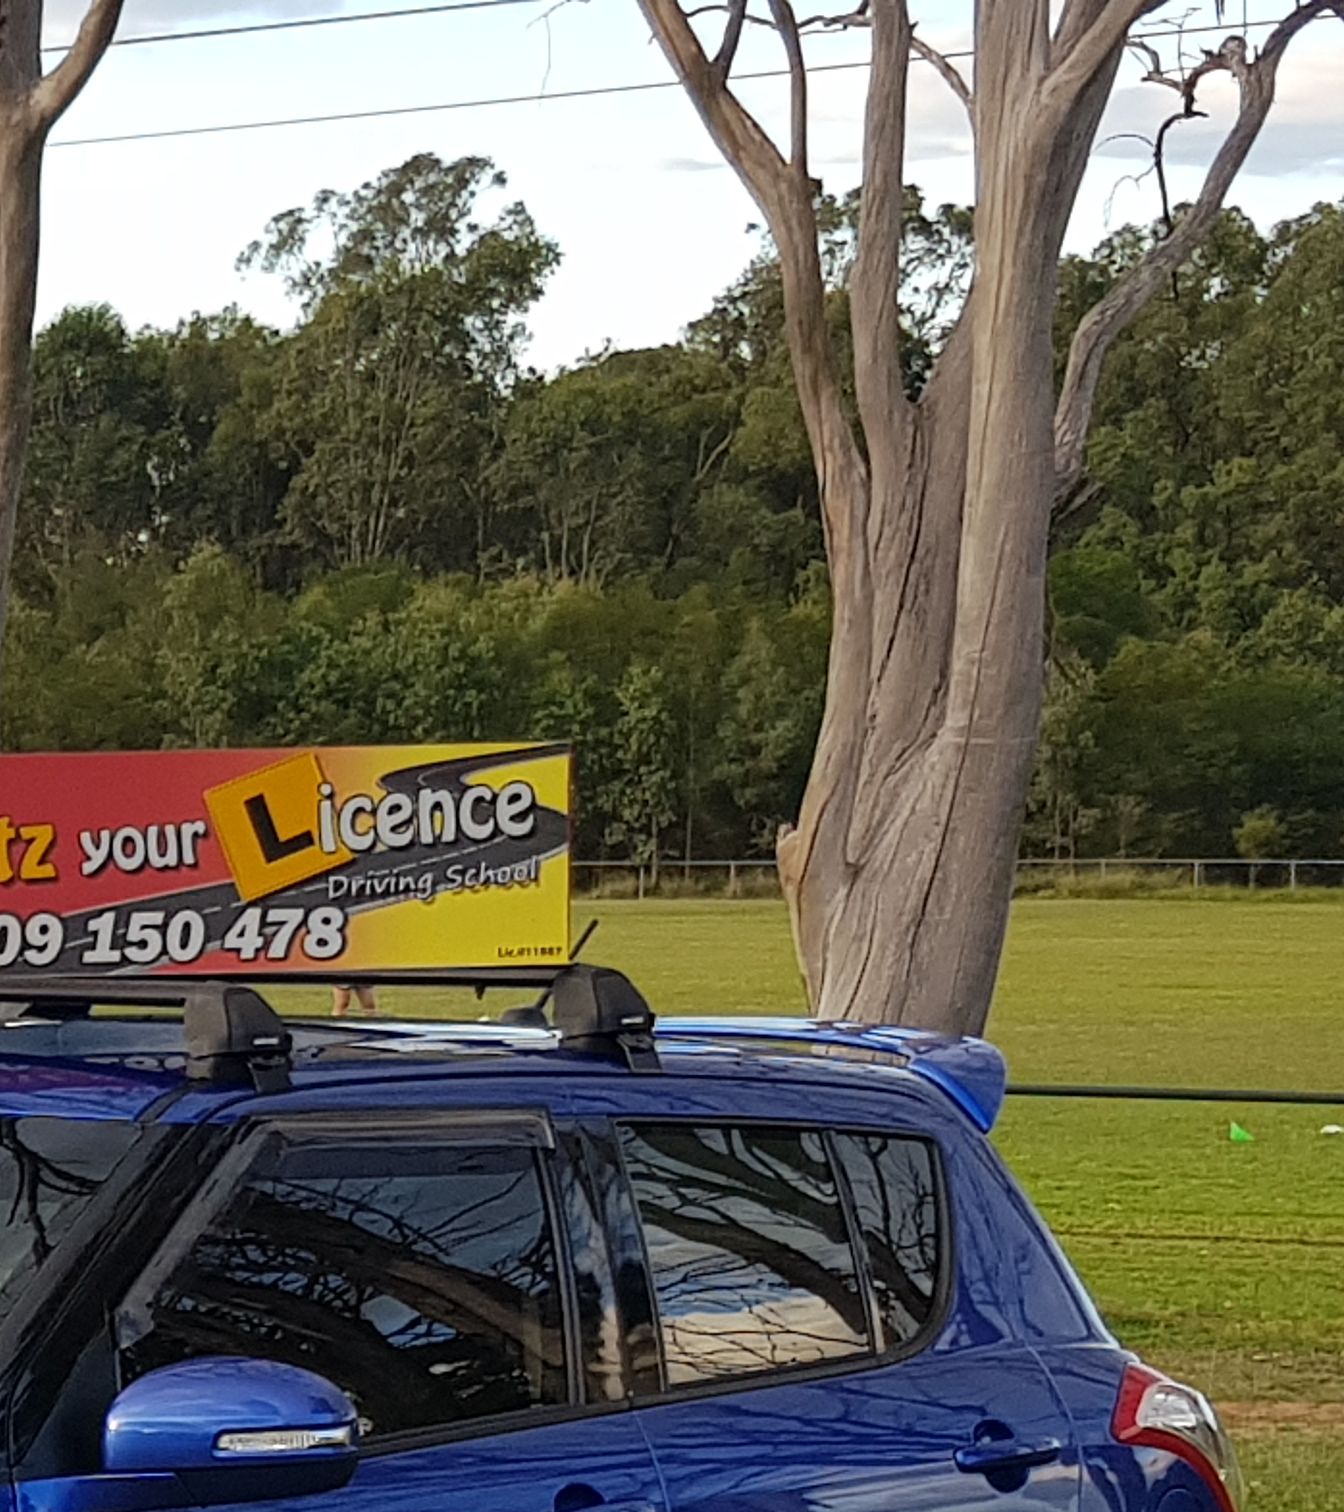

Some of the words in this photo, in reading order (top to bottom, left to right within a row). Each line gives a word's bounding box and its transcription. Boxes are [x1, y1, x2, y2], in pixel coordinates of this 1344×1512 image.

[79, 820, 207, 876] your
[243, 781, 535, 865] Licence
[327, 868, 433, 900] Driving
[445, 856, 541, 891] School
[80, 909, 205, 964] 150
[223, 905, 345, 961] 478
